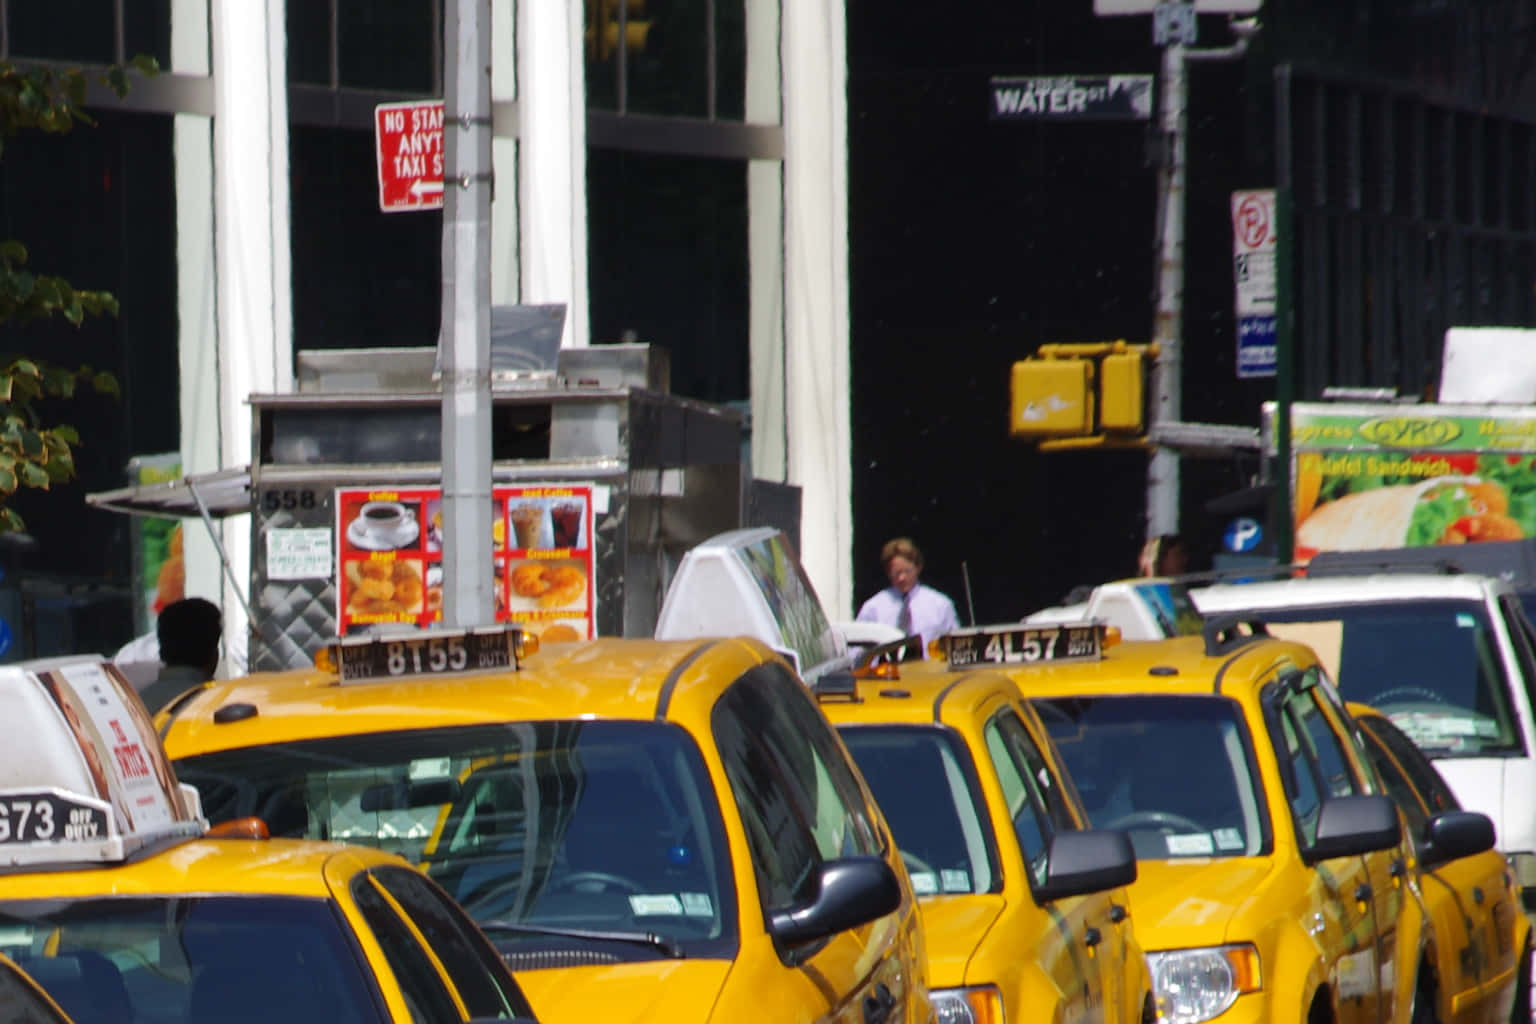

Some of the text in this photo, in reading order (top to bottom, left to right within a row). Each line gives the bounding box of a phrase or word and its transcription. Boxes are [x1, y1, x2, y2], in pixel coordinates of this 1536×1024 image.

[995, 87, 1087, 113] WATER
[385, 112, 405, 133] NO
[394, 154, 426, 178] TAXI
[1366, 456, 1451, 477] Sandwich
[387, 637, 468, 676] 8T55
[952, 650, 979, 665] DUTY
[984, 630, 1060, 664] 4L57
[1067, 641, 1094, 656] DUTY
[479, 653, 510, 667] DUTY
[70, 808, 93, 824] OFF
[64, 823, 98, 840] DUTY
